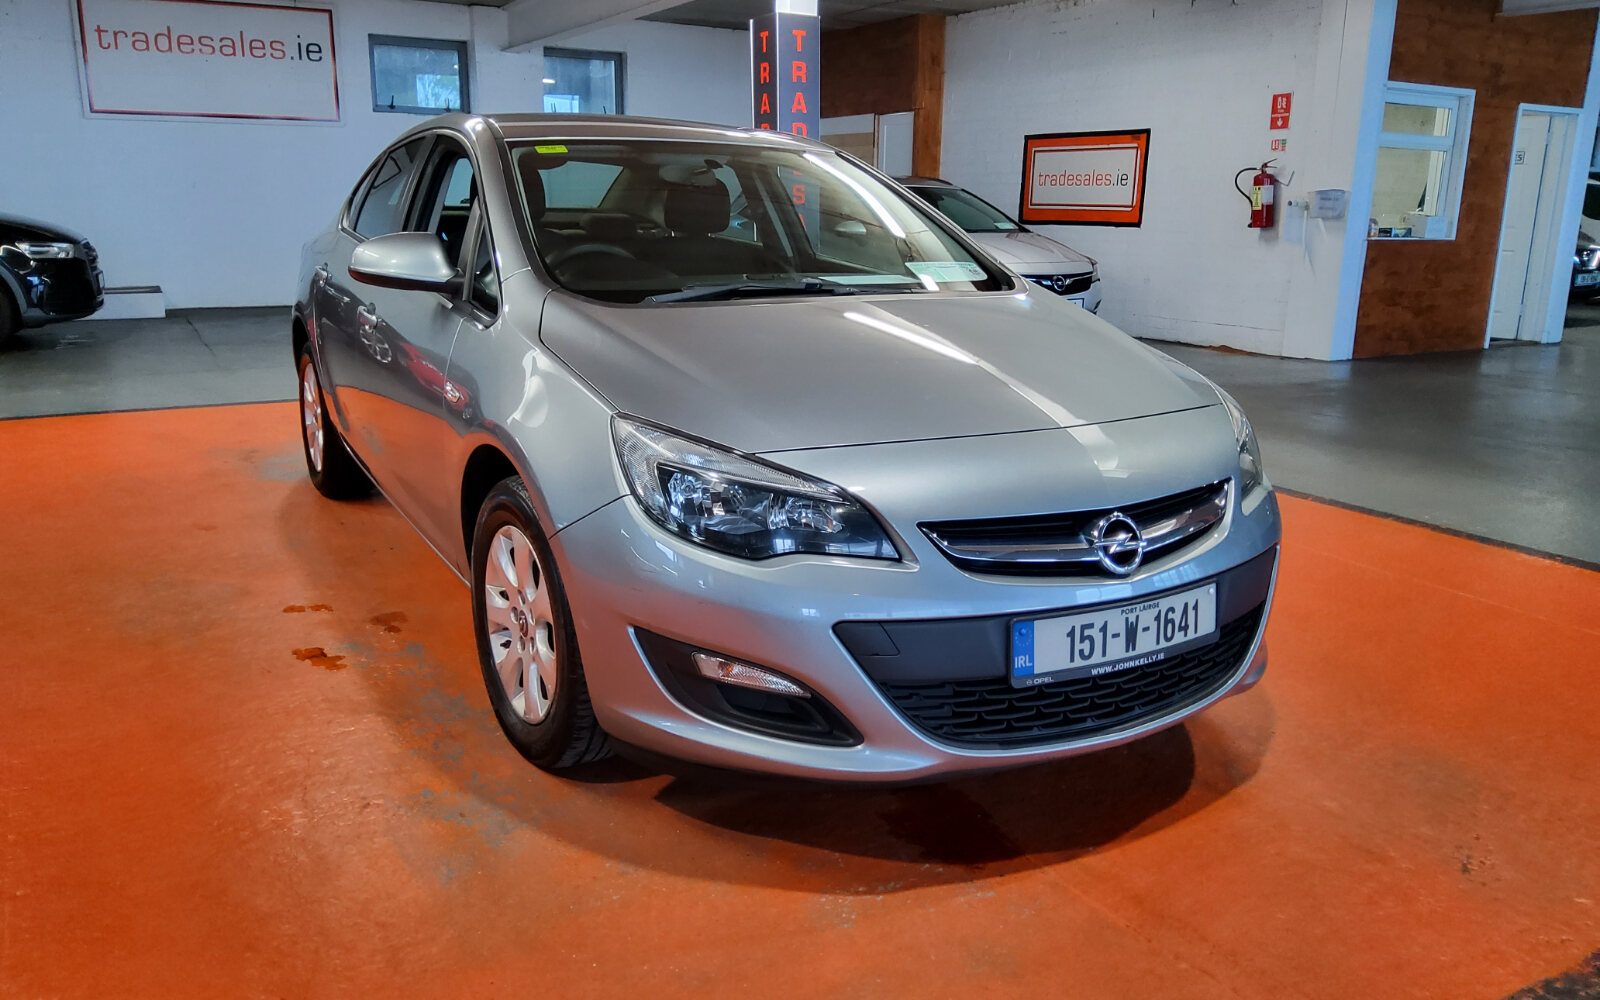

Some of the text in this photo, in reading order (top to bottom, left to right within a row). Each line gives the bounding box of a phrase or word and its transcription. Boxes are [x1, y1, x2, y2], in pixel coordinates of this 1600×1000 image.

[94, 24, 324, 63] tradesales.ie
[760, 30, 770, 130] TRA
[791, 29, 807, 138] TRAD
[1038, 168, 1129, 187] tradesales.ie
[1120, 605, 1138, 616] PORT
[1066, 598, 1199, 664] 151-W-1641
[1014, 654, 1033, 669] IRL
[1091, 652, 1165, 676] WWW.JOHNKELLY.IE
[1033, 676, 1055, 686] OPEL
